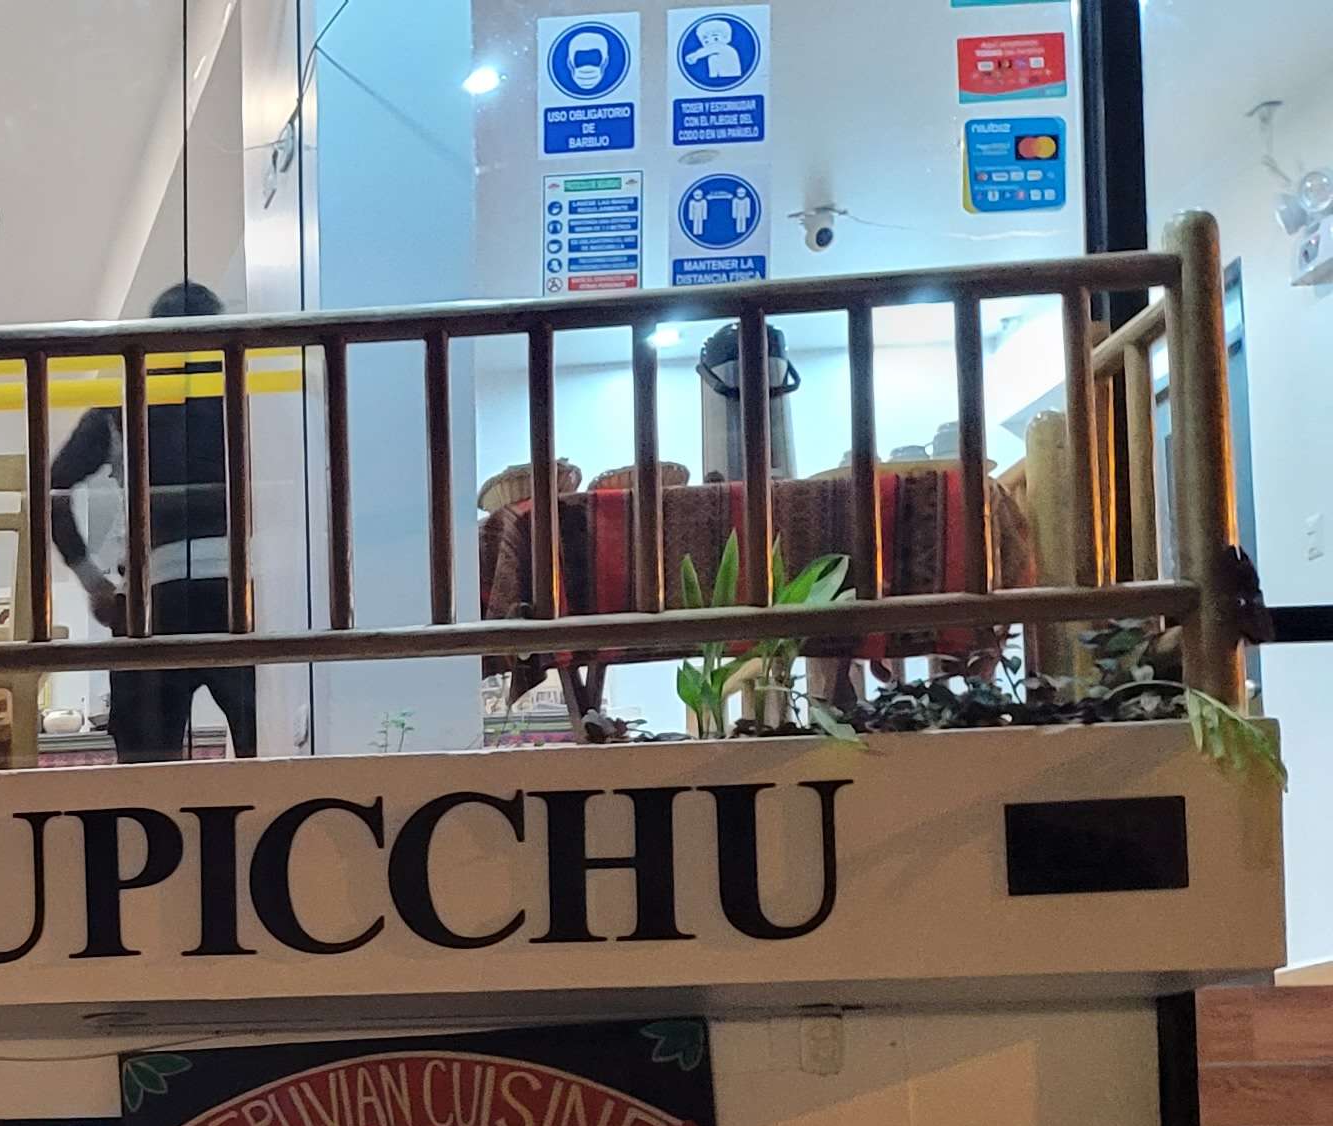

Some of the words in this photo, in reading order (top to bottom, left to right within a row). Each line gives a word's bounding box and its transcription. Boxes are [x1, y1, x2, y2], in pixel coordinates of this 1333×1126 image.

[547, 110, 567, 122] USO
[568, 106, 631, 121] OBLIGATORIO
[581, 123, 596, 134] DE
[568, 136, 610, 148] BARBIJO
[683, 259, 739, 272] MANTENER
[740, 258, 755, 269] LA
[675, 272, 729, 286] DISTANCIA
